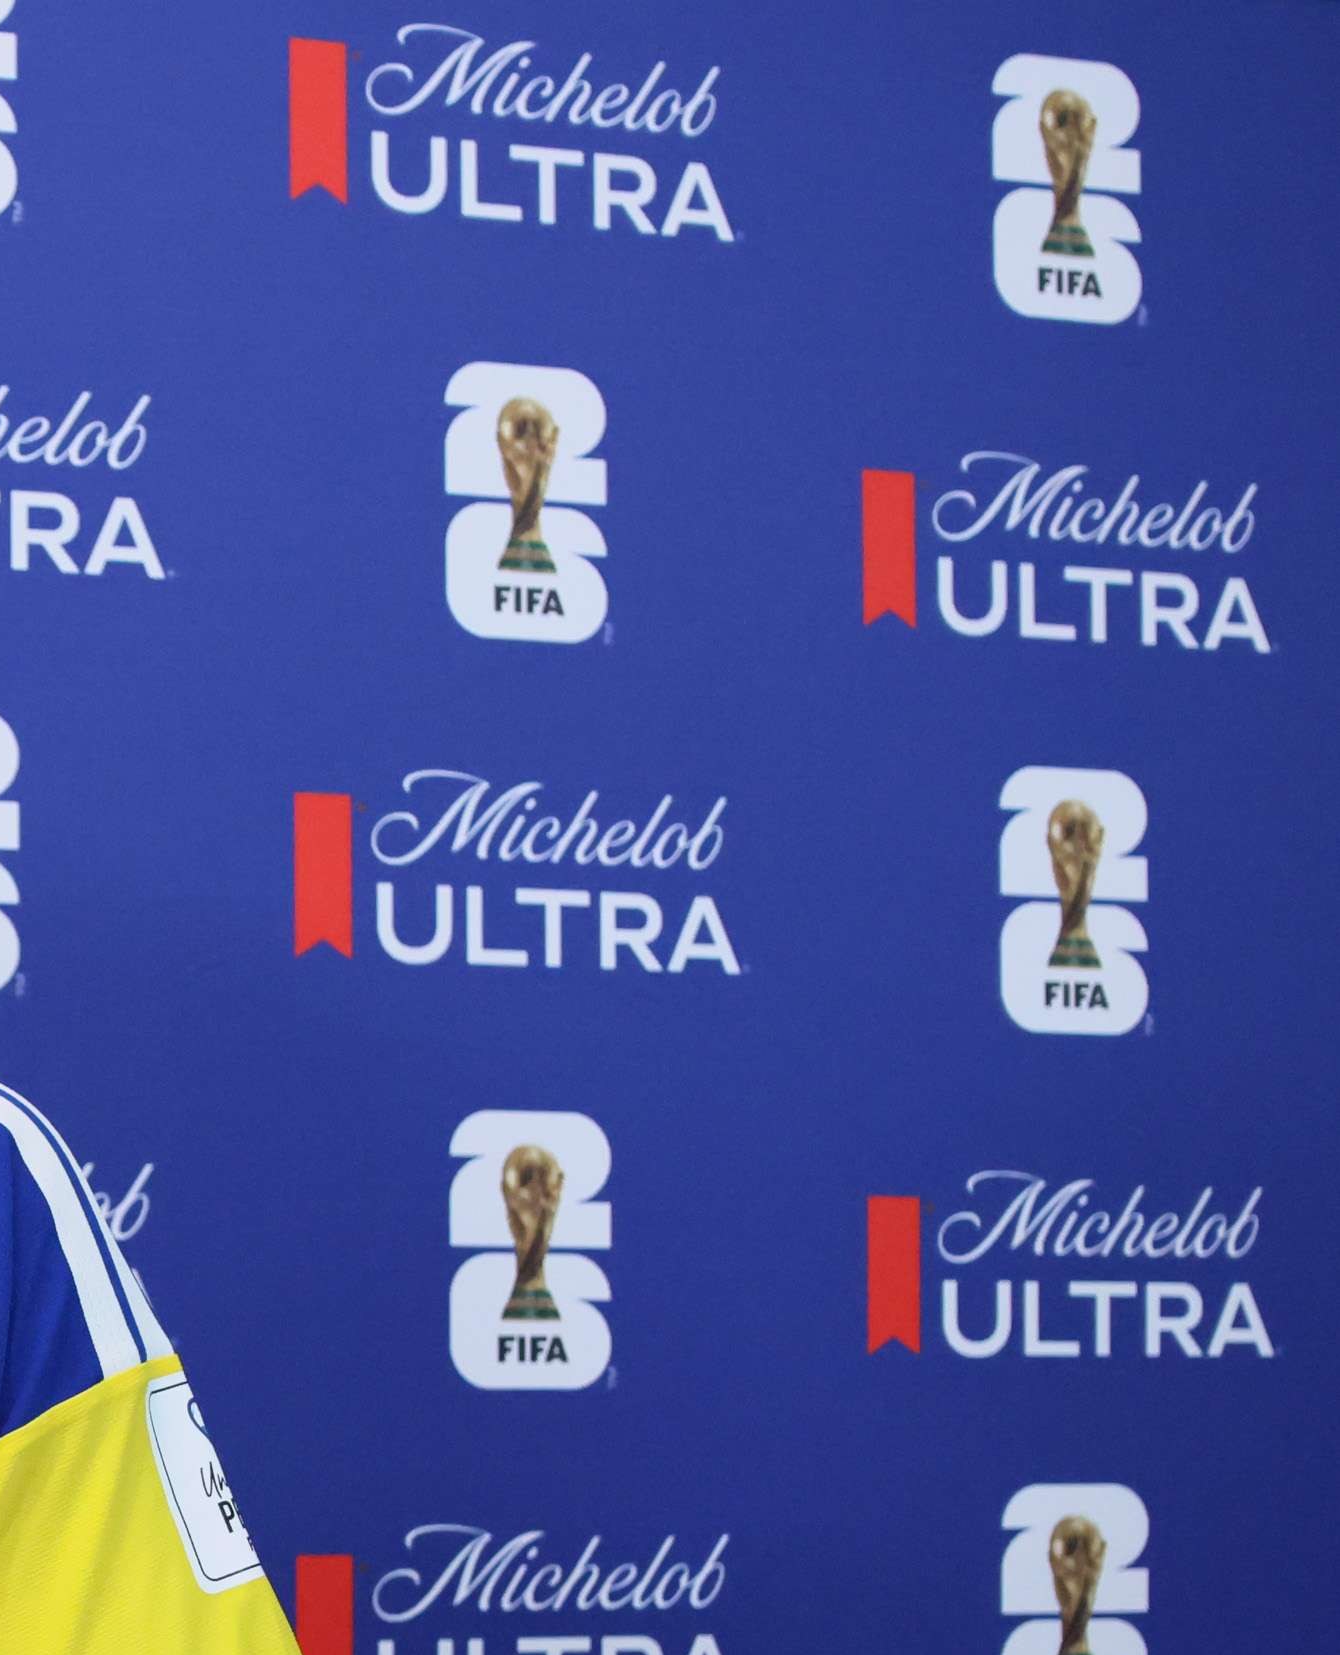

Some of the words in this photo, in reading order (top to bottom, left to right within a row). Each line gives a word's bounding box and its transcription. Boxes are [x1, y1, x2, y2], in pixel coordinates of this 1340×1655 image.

[366, 23, 719, 137] Michelob
[371, 131, 734, 242] ULTRA
[1039, 268, 1101, 297] FIFA
[932, 451, 1257, 552] Michelob
[495, 586, 563, 615] FIFA
[937, 557, 1270, 653] ULTRA
[371, 770, 726, 870] Michelob
[376, 882, 740, 975] ULTRA
[1045, 983, 1107, 1008] FIFA
[938, 1171, 1261, 1264] Michelob
[499, 1337, 567, 1362] FIFA
[942, 1280, 1273, 1358] ULTRA
[373, 1524, 728, 1622] Michelob
